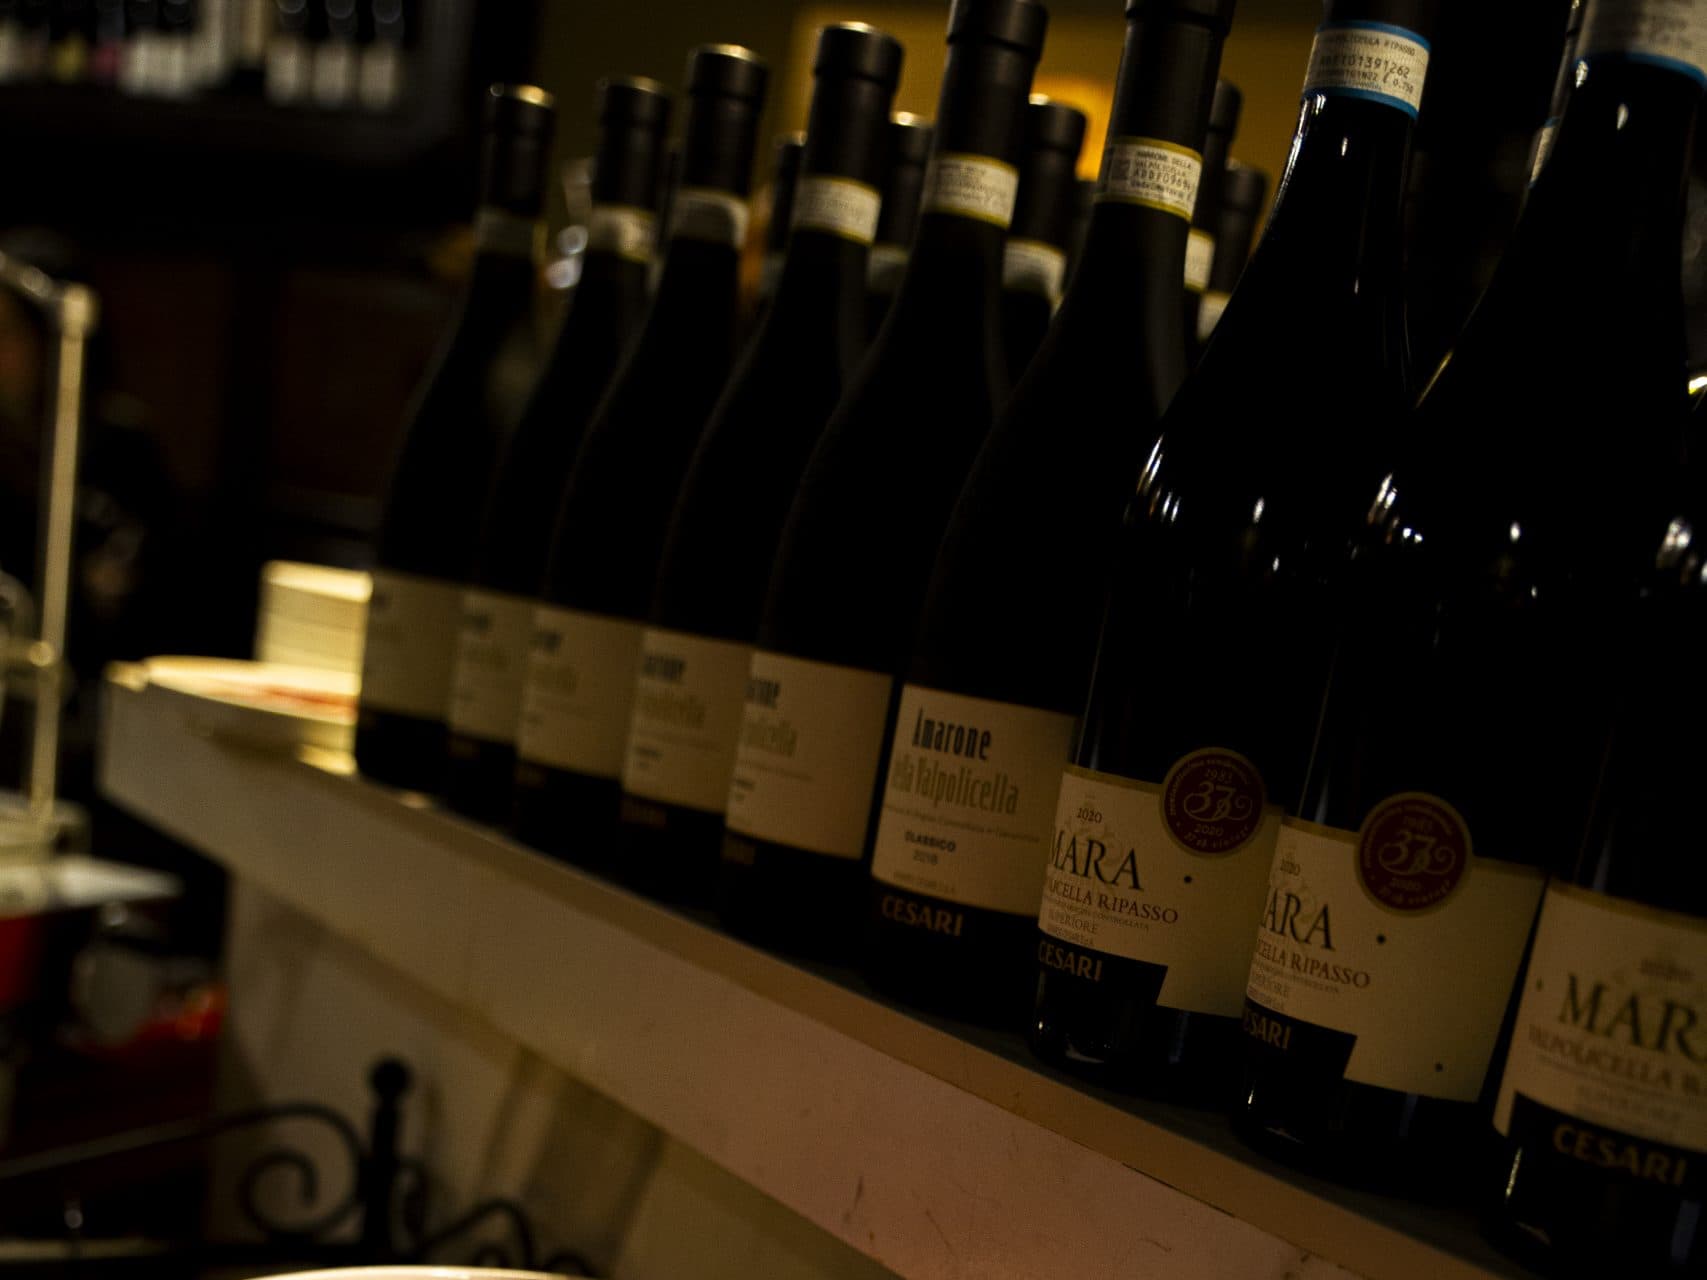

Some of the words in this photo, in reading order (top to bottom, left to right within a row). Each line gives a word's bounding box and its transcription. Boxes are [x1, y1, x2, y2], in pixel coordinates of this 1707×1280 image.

[911, 706, 992, 760] Amarone
[915, 756, 1018, 815] Valpolicella
[881, 894, 965, 937] CESARI
[1098, 894, 1179, 925] RIPASSO
[1260, 887, 1336, 952] ARA
[1291, 952, 1370, 989] RIPASSO
[1557, 972, 1707, 1068] MAR
[1551, 1120, 1689, 1188] CESARI
